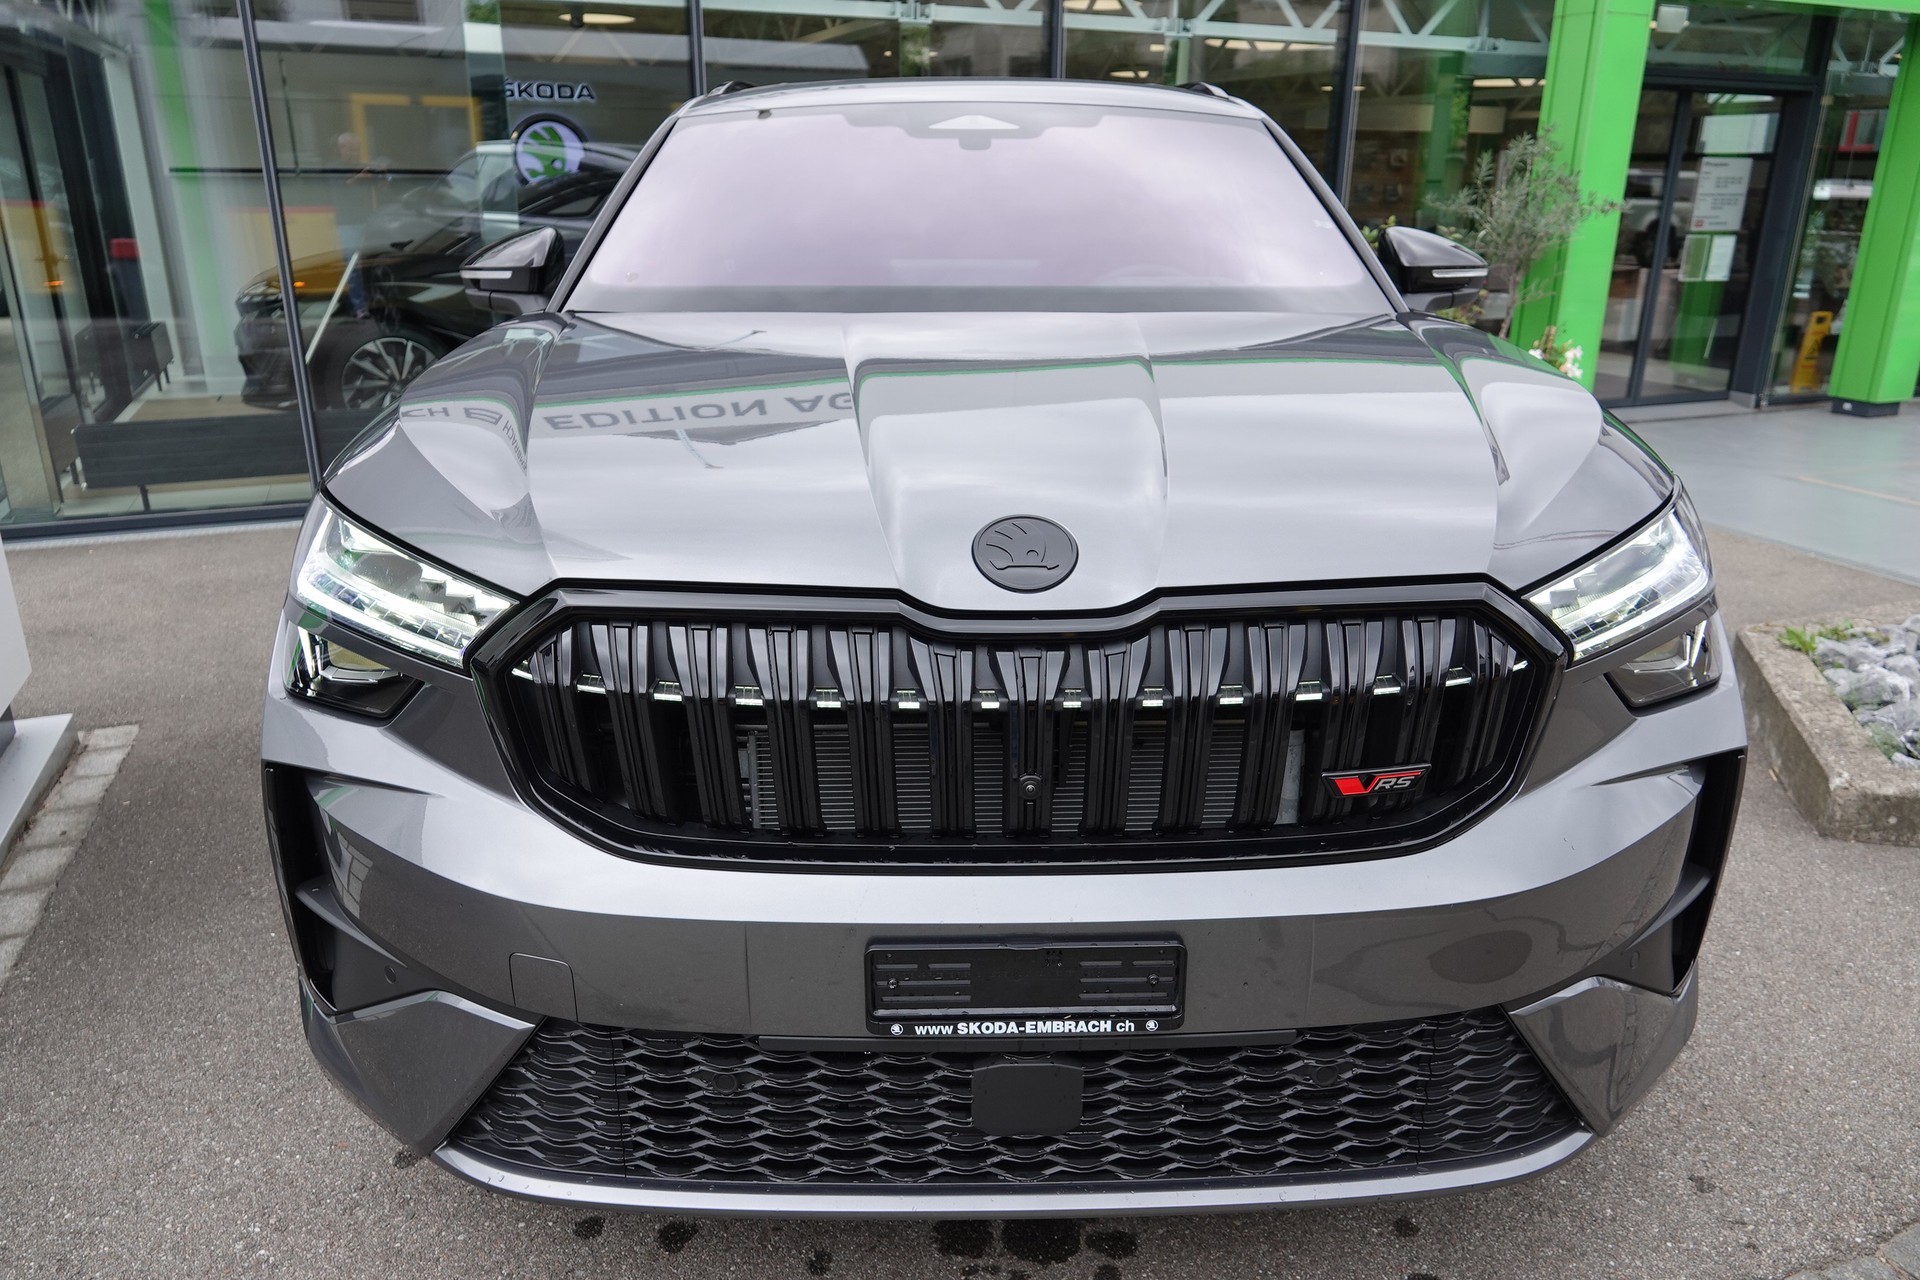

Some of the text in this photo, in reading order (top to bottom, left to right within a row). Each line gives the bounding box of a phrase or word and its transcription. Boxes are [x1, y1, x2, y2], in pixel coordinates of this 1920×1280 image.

[914, 1020, 1136, 1036] www SKODA-EMBRACH ch
